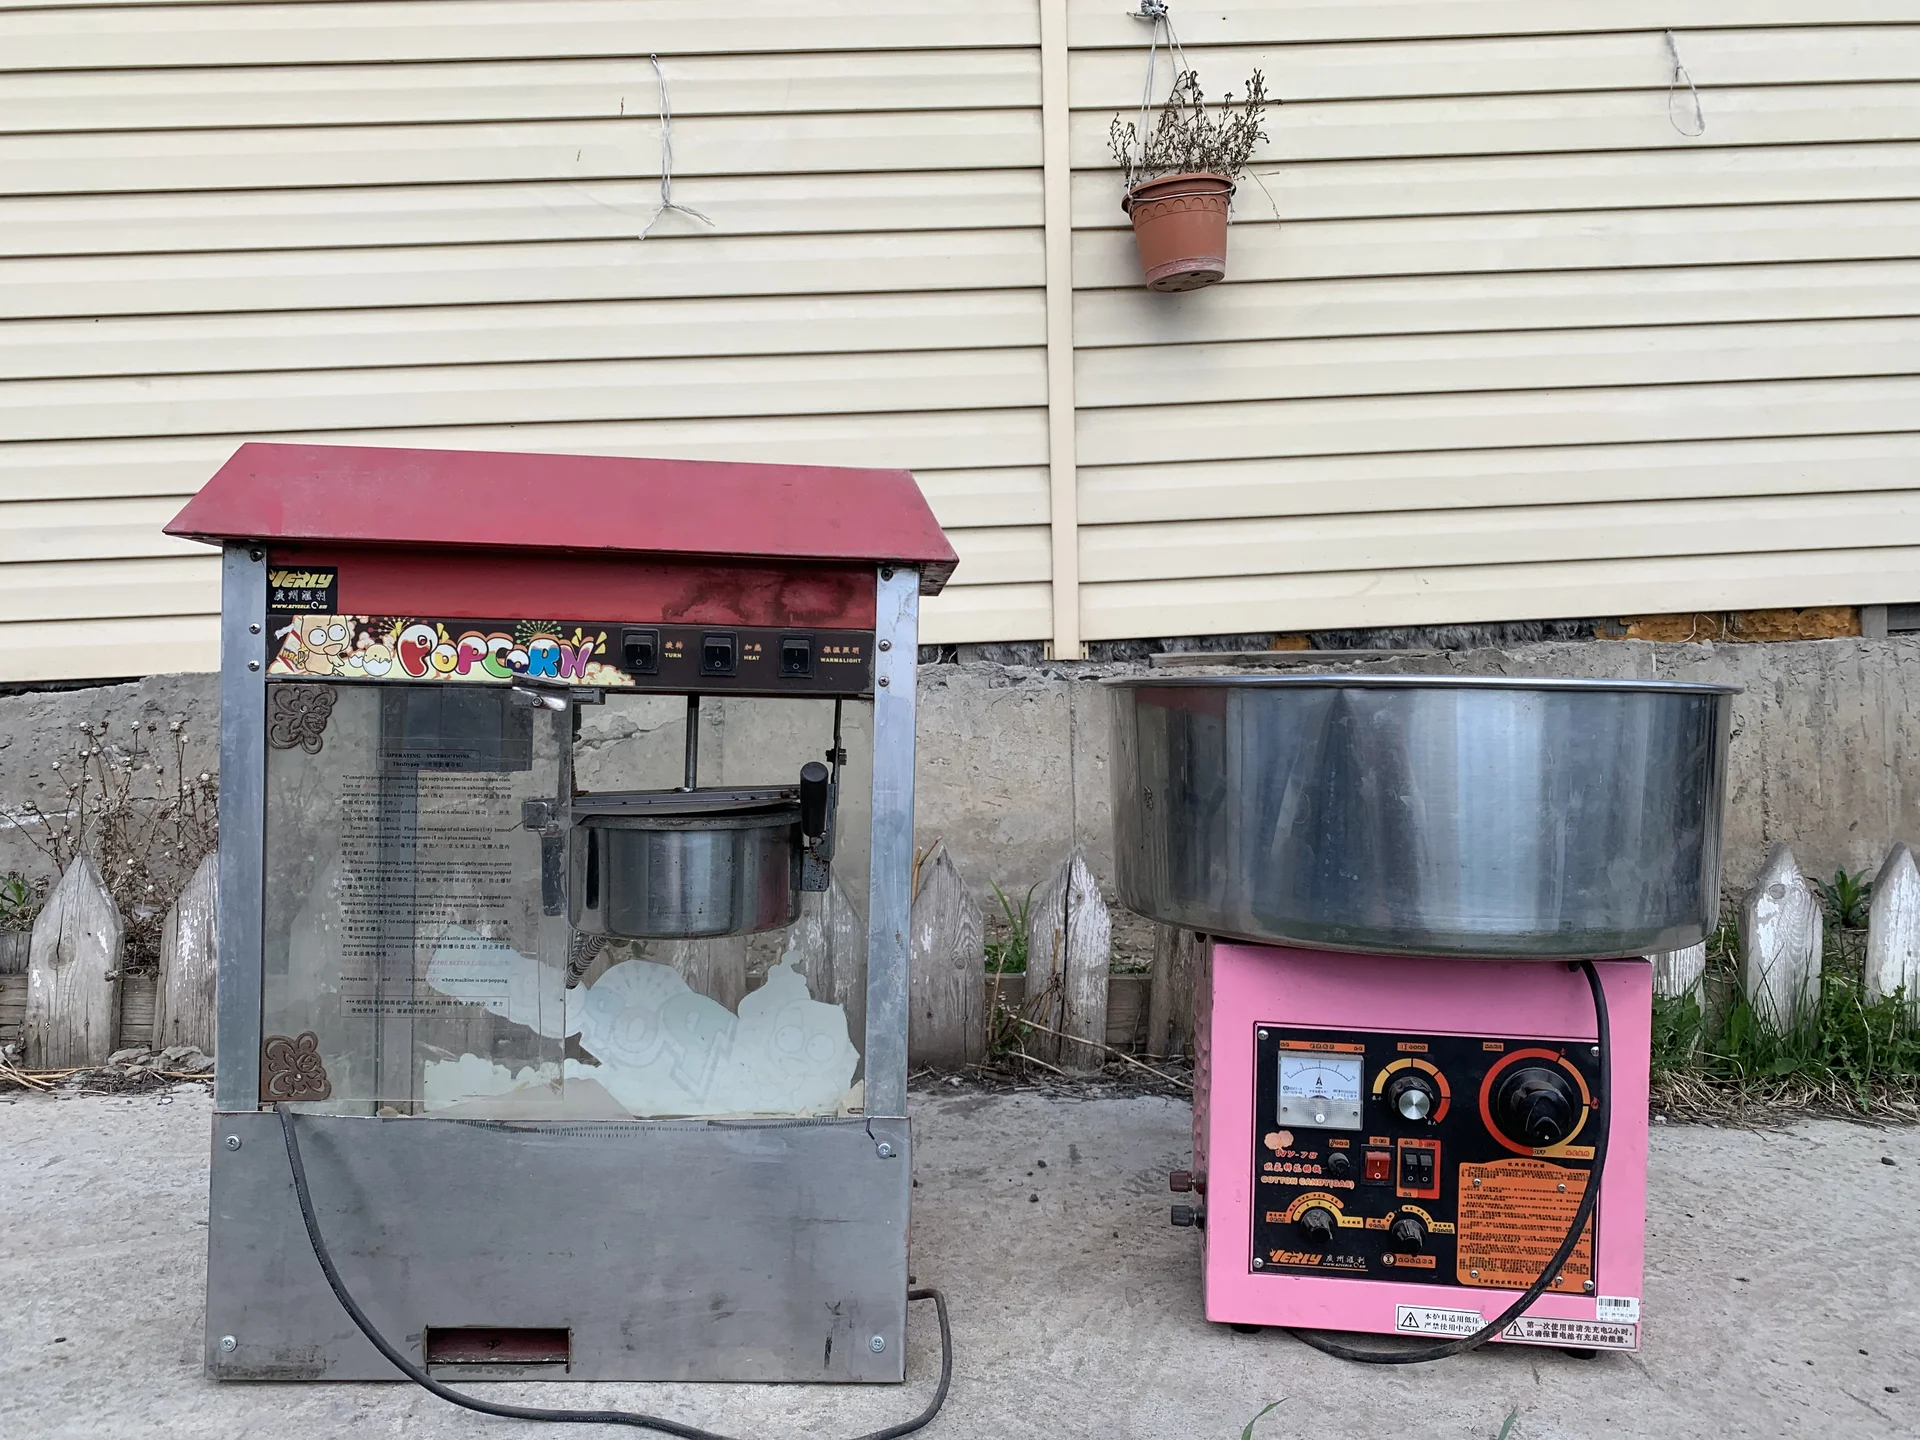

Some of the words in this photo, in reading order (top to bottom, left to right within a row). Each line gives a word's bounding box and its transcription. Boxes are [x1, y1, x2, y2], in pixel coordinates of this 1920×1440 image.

[1315, 1076, 1323, 1086] A
[1275, 1150, 1318, 1159] WY-78
[1260, 1176, 1298, 1185] COTTON
[1299, 1178, 1355, 1190] CANDY(GAS)
